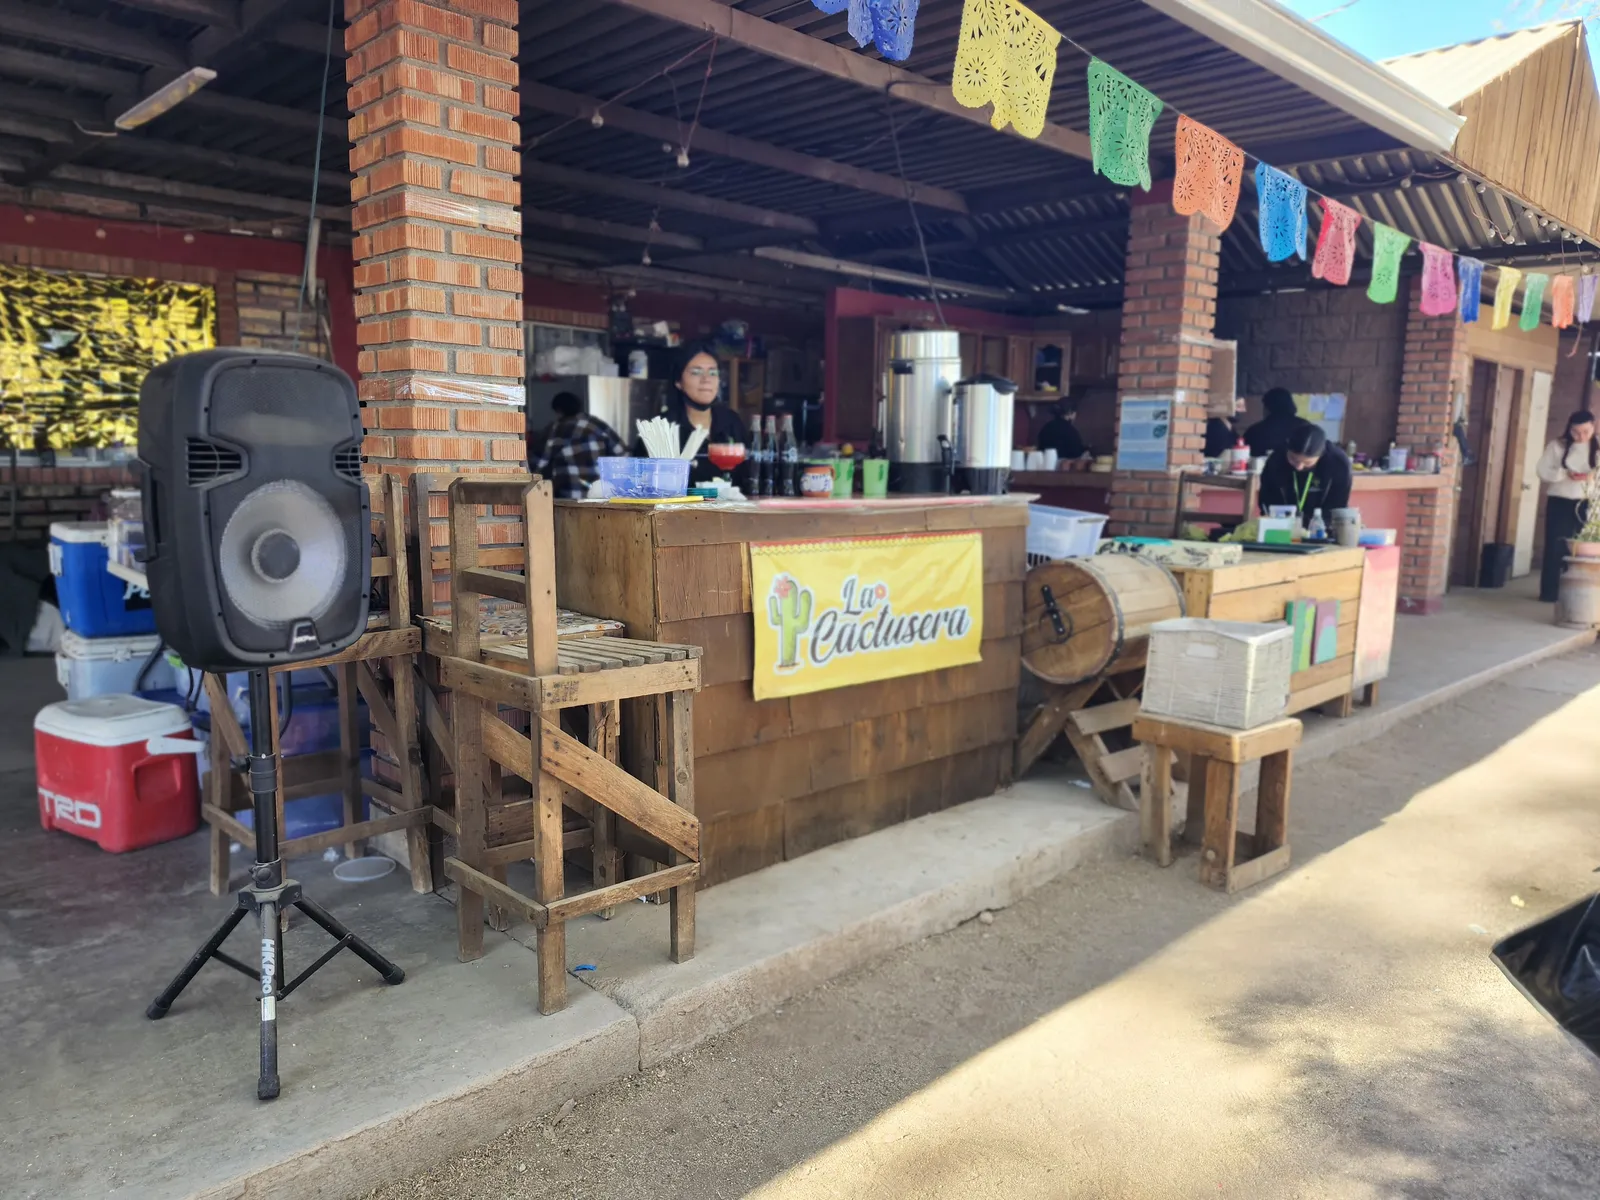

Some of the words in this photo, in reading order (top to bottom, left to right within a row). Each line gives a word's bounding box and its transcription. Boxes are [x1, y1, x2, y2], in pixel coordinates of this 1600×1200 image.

[842, 577, 877, 617] La
[810, 603, 971, 664] Cactusera
[37, 786, 102, 829] TRD
